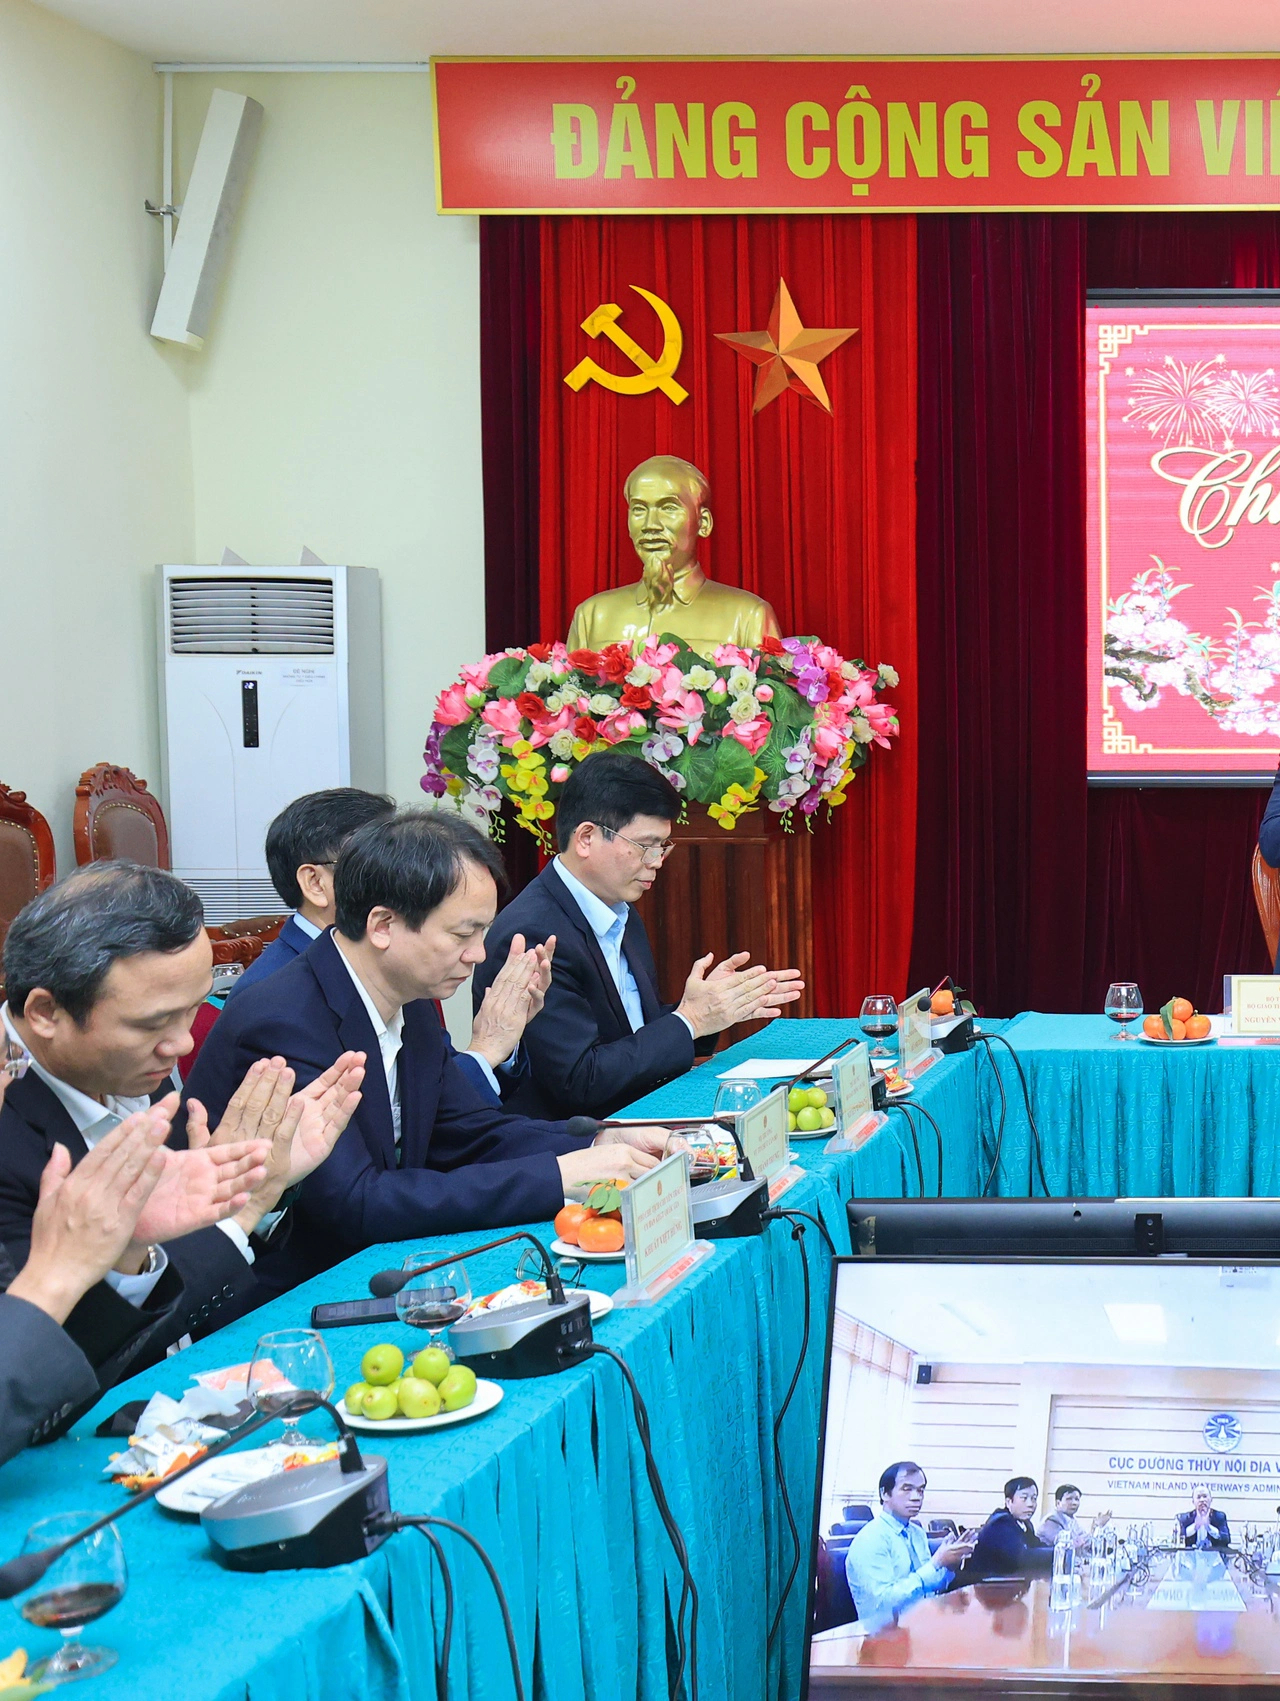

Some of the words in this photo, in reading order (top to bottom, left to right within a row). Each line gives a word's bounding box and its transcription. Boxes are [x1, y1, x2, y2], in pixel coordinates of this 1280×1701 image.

[551, 76, 758, 180] ĐẢNG
[785, 85, 990, 197] CỘNG
[1016, 74, 1172, 180] SẢN
[1109, 1457, 1134, 1470] CỤC
[1224, 1459, 1246, 1474] NỘI
[1107, 1480, 1150, 1490] VIETNAM
[1152, 1481, 1188, 1490] INLAND
